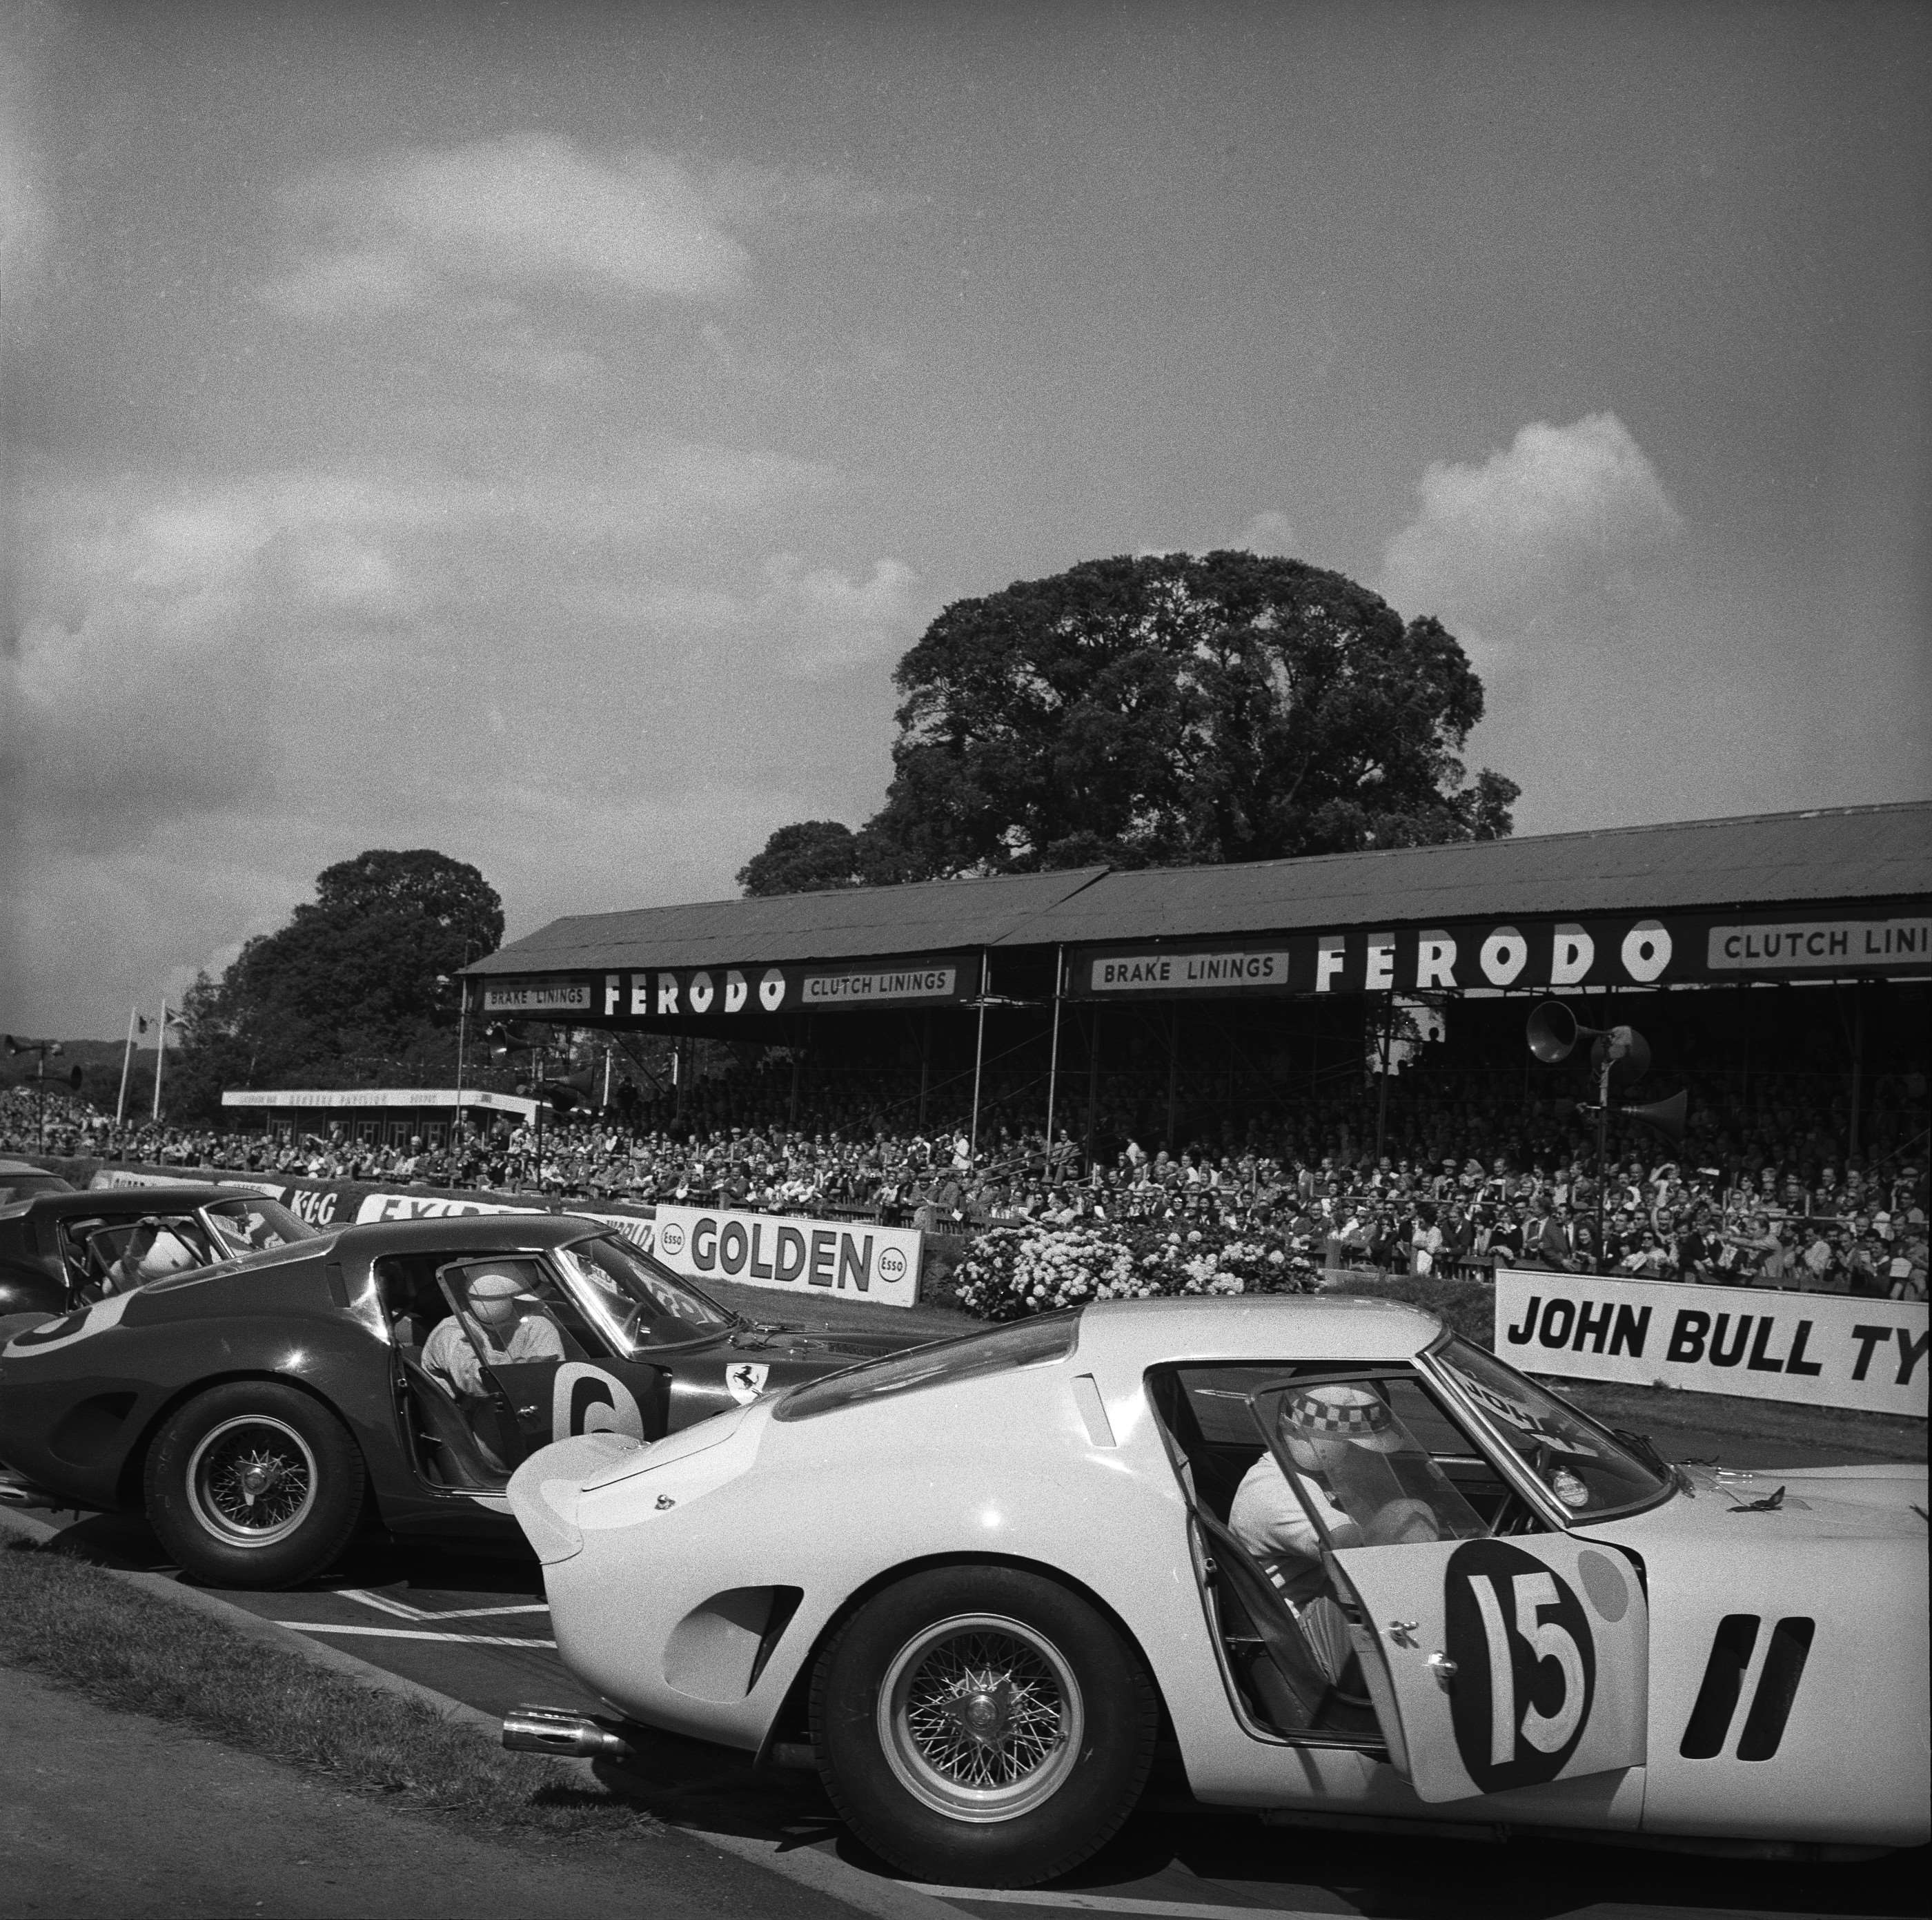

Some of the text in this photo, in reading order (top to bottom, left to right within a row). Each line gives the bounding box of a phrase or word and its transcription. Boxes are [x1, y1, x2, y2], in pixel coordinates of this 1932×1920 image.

[1315, 919, 1673, 992] FERODO
[1725, 927, 1928, 959] CLUTCH LINI
[604, 968, 786, 1016] FERODO
[810, 972, 947, 996] CLUTCH LININGS
[1104, 956, 1274, 984] BRAKE LININGS
[491, 988, 583, 1005] BRAKE LININGS
[663, 1217, 904, 1293] Esso GOLDEN Esso
[1507, 1295, 1929, 1386] JOHN BULL TY
[1467, 1571, 1586, 1765] 15
